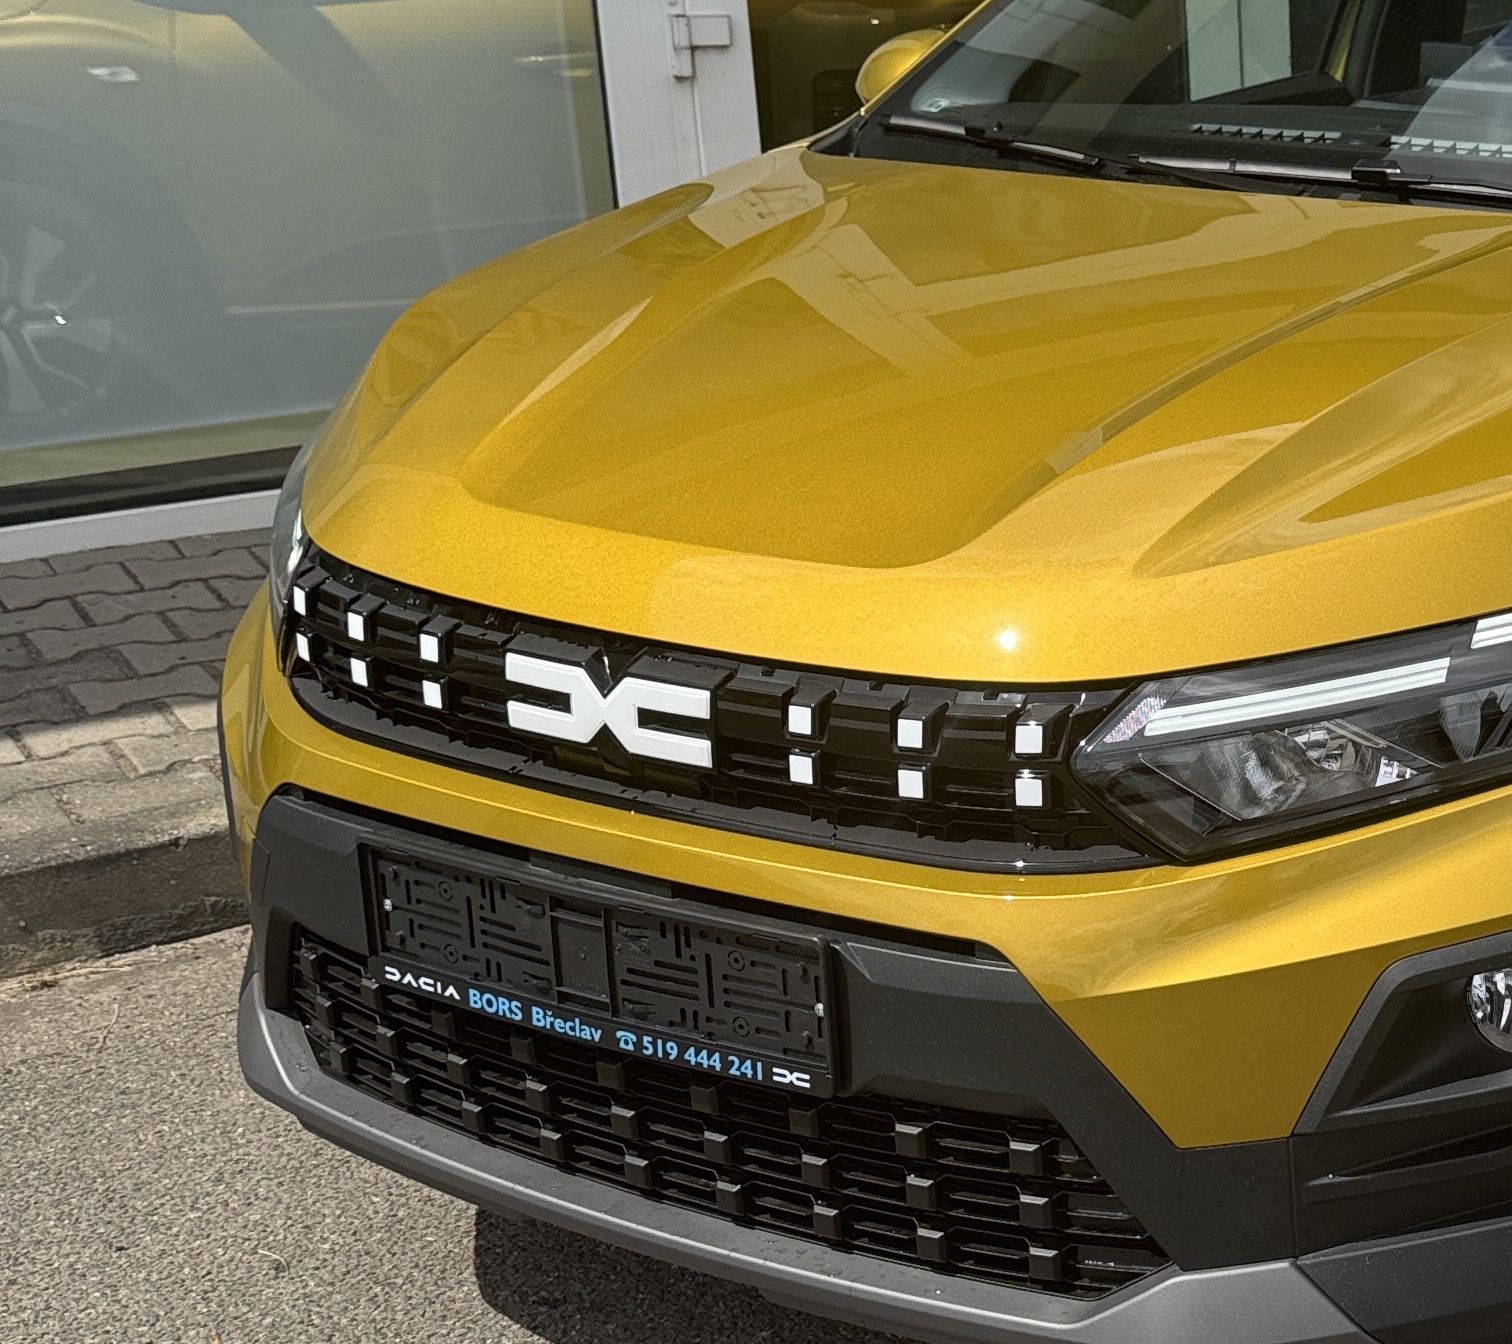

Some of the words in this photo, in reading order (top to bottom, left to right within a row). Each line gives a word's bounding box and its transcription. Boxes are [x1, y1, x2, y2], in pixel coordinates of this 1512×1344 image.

[384, 965, 461, 1000] DACIA
[468, 988, 523, 1021] BORS
[531, 1006, 602, 1042] Břeclav
[642, 1035, 679, 1061] 519
[683, 1046, 722, 1072] 444
[727, 1055, 763, 1081] 241
